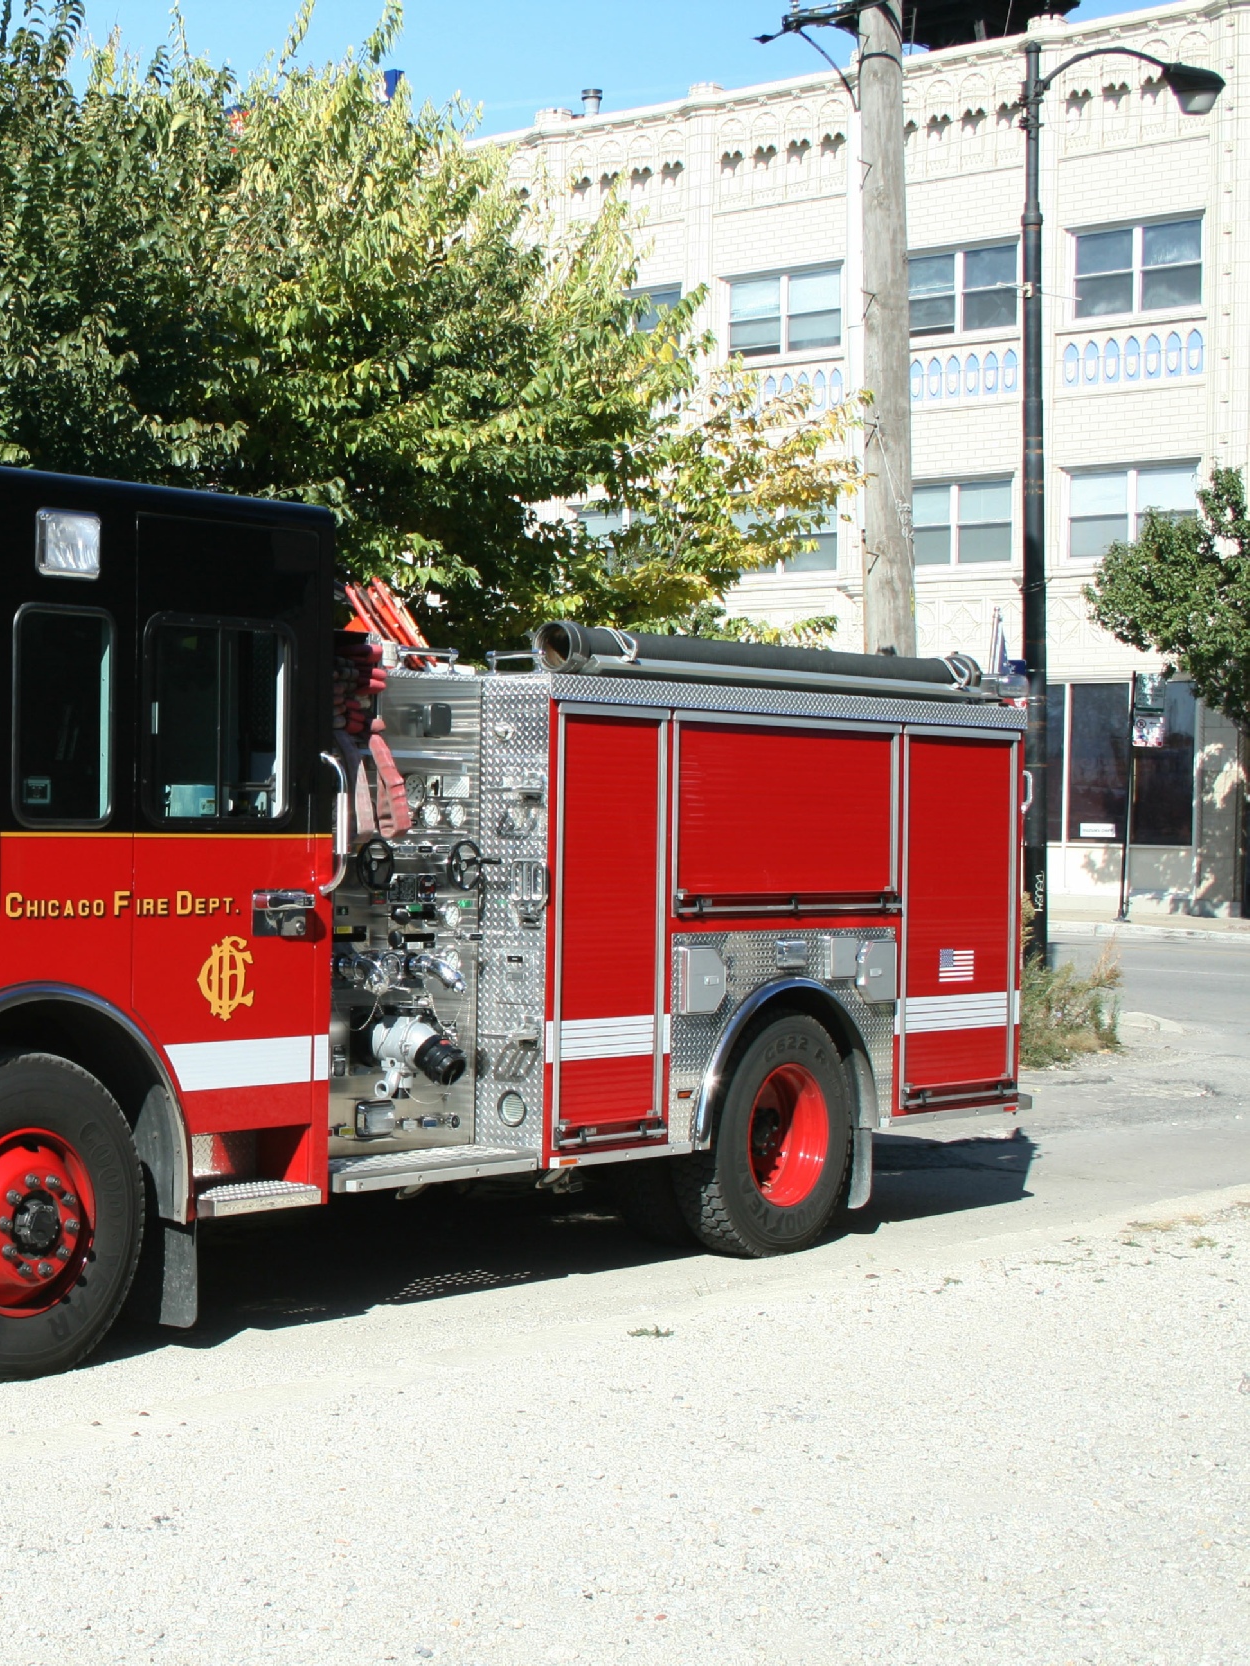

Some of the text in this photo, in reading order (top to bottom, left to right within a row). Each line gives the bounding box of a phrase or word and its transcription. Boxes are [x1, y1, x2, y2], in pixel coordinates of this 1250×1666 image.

[5, 890, 242, 918] CHICAGO FIRE DEPT.
